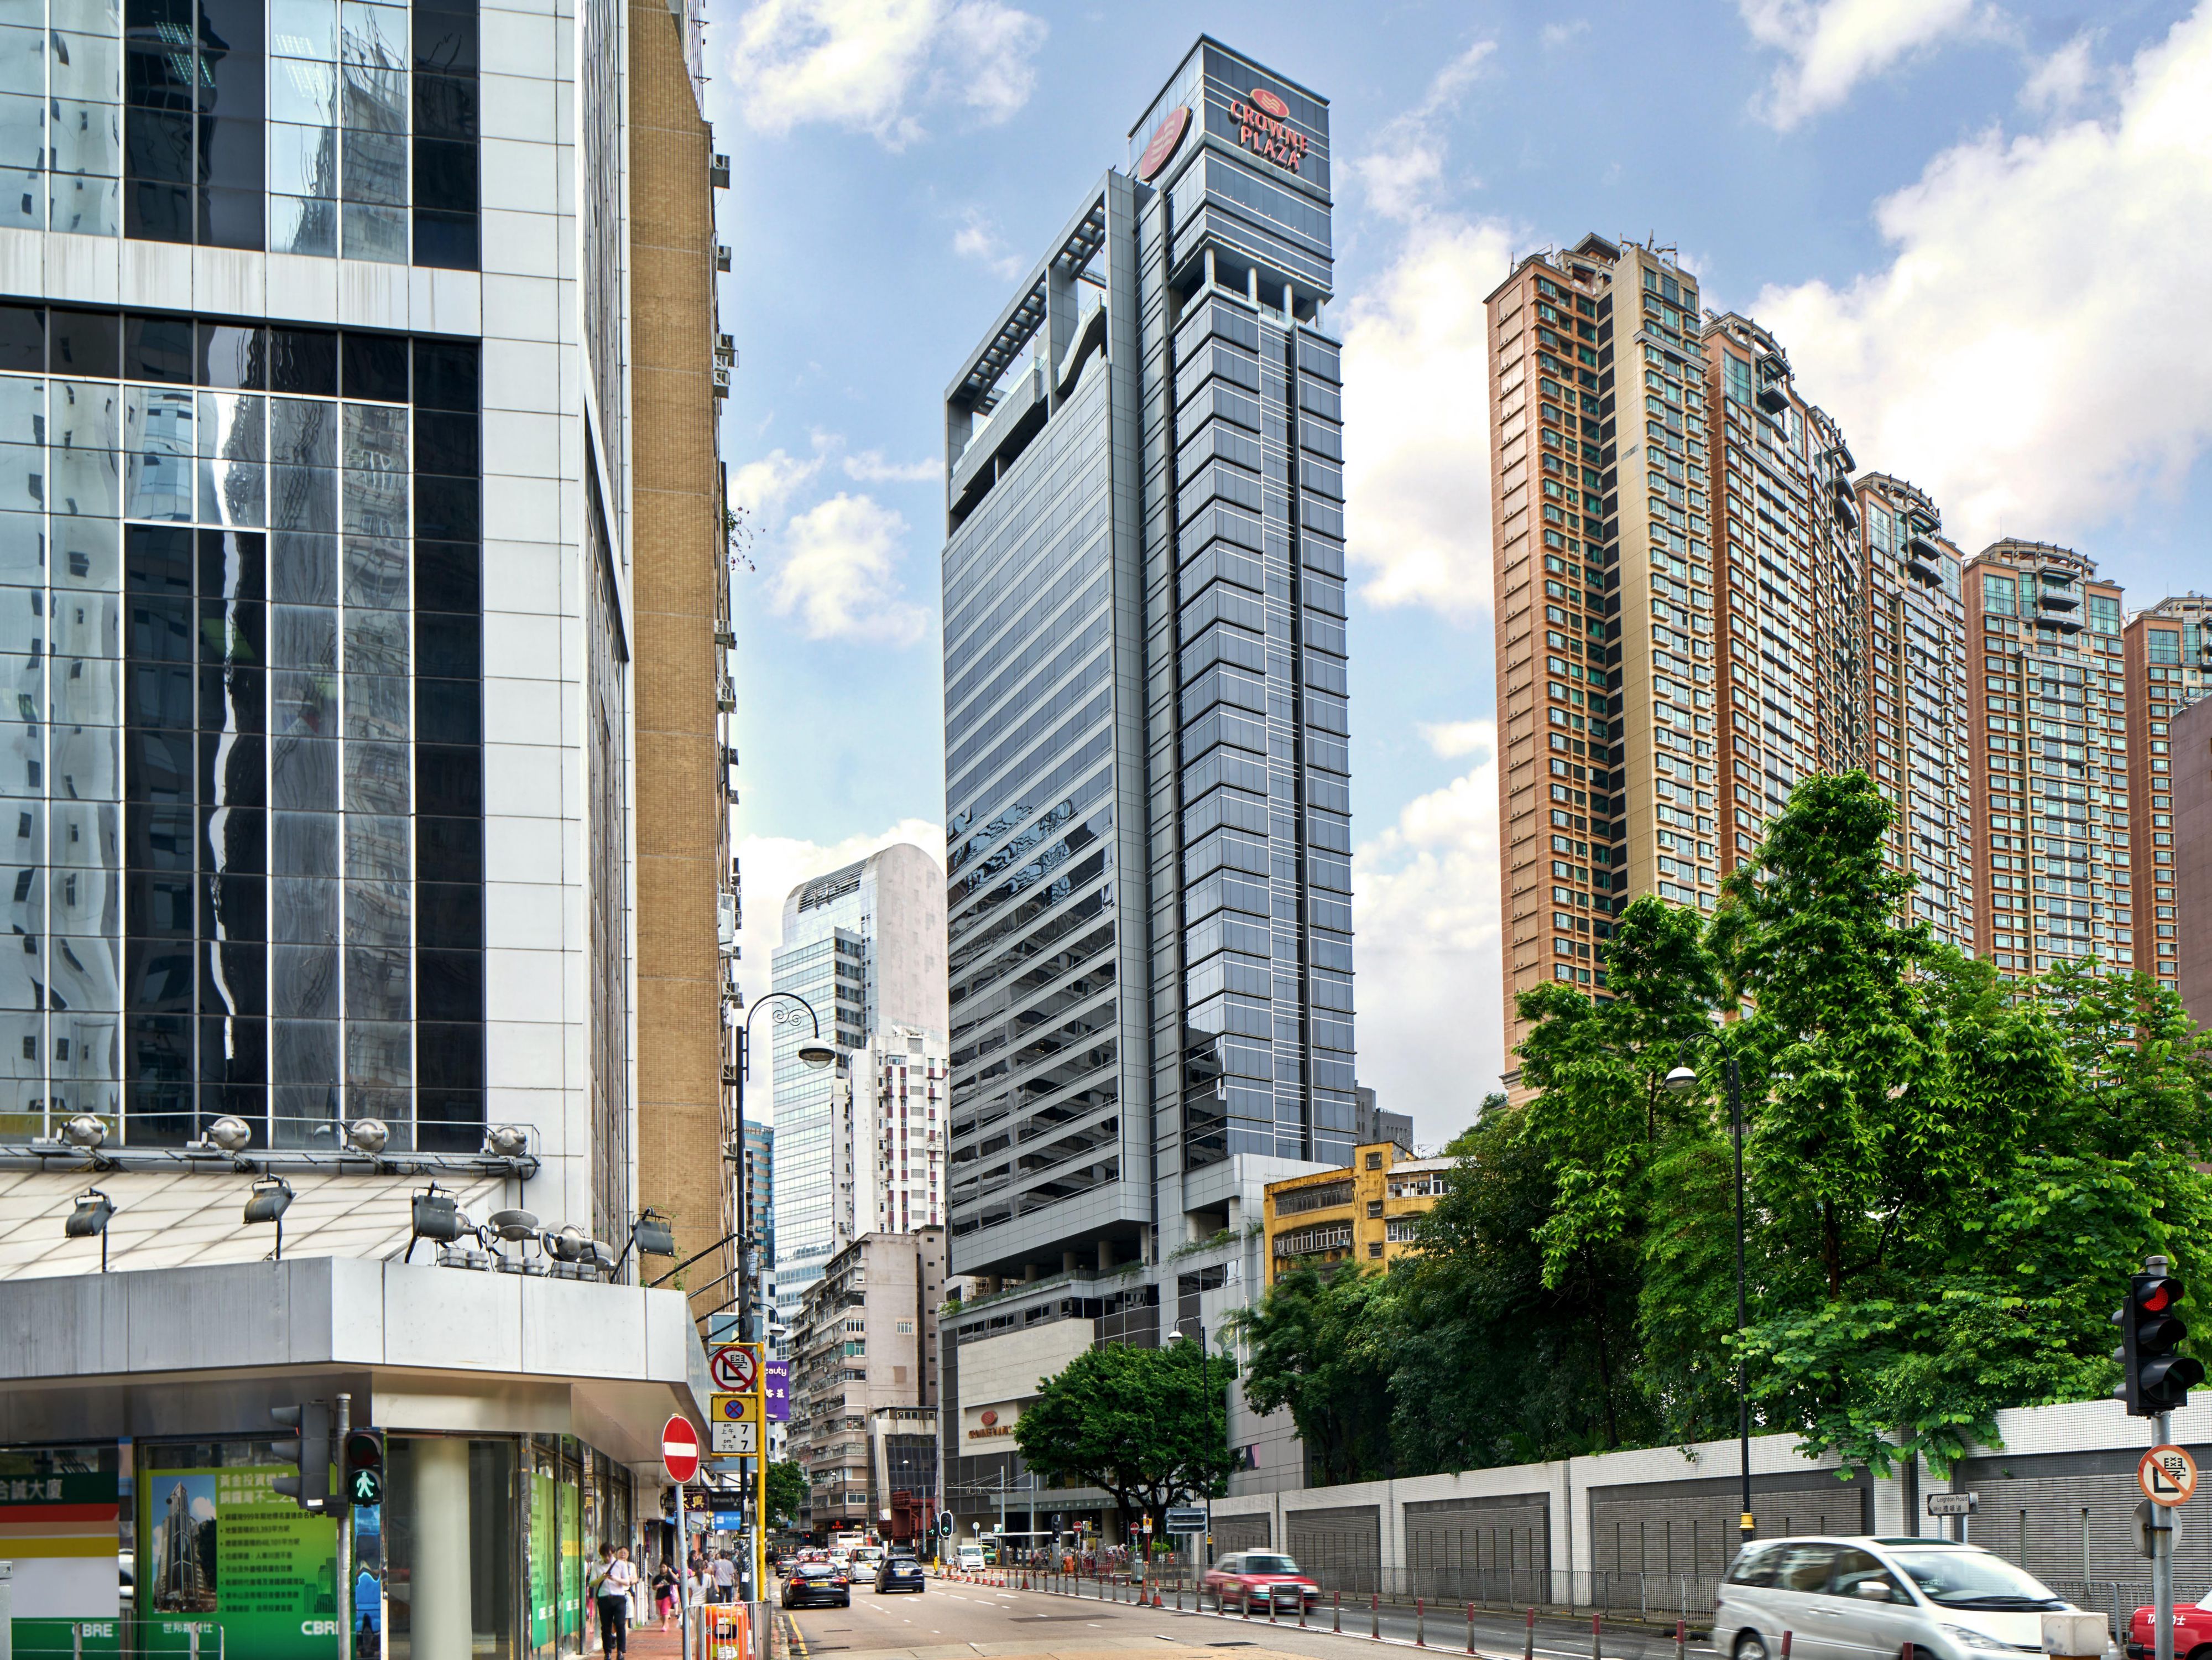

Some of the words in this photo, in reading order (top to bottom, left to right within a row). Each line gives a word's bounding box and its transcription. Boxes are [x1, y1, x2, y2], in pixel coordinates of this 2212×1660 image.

[1230, 100, 1308, 152] CROWNE
[1240, 124, 1300, 173] PLAZA
[741, 1424, 748, 1434] 7
[741, 1440, 748, 1450] 7
